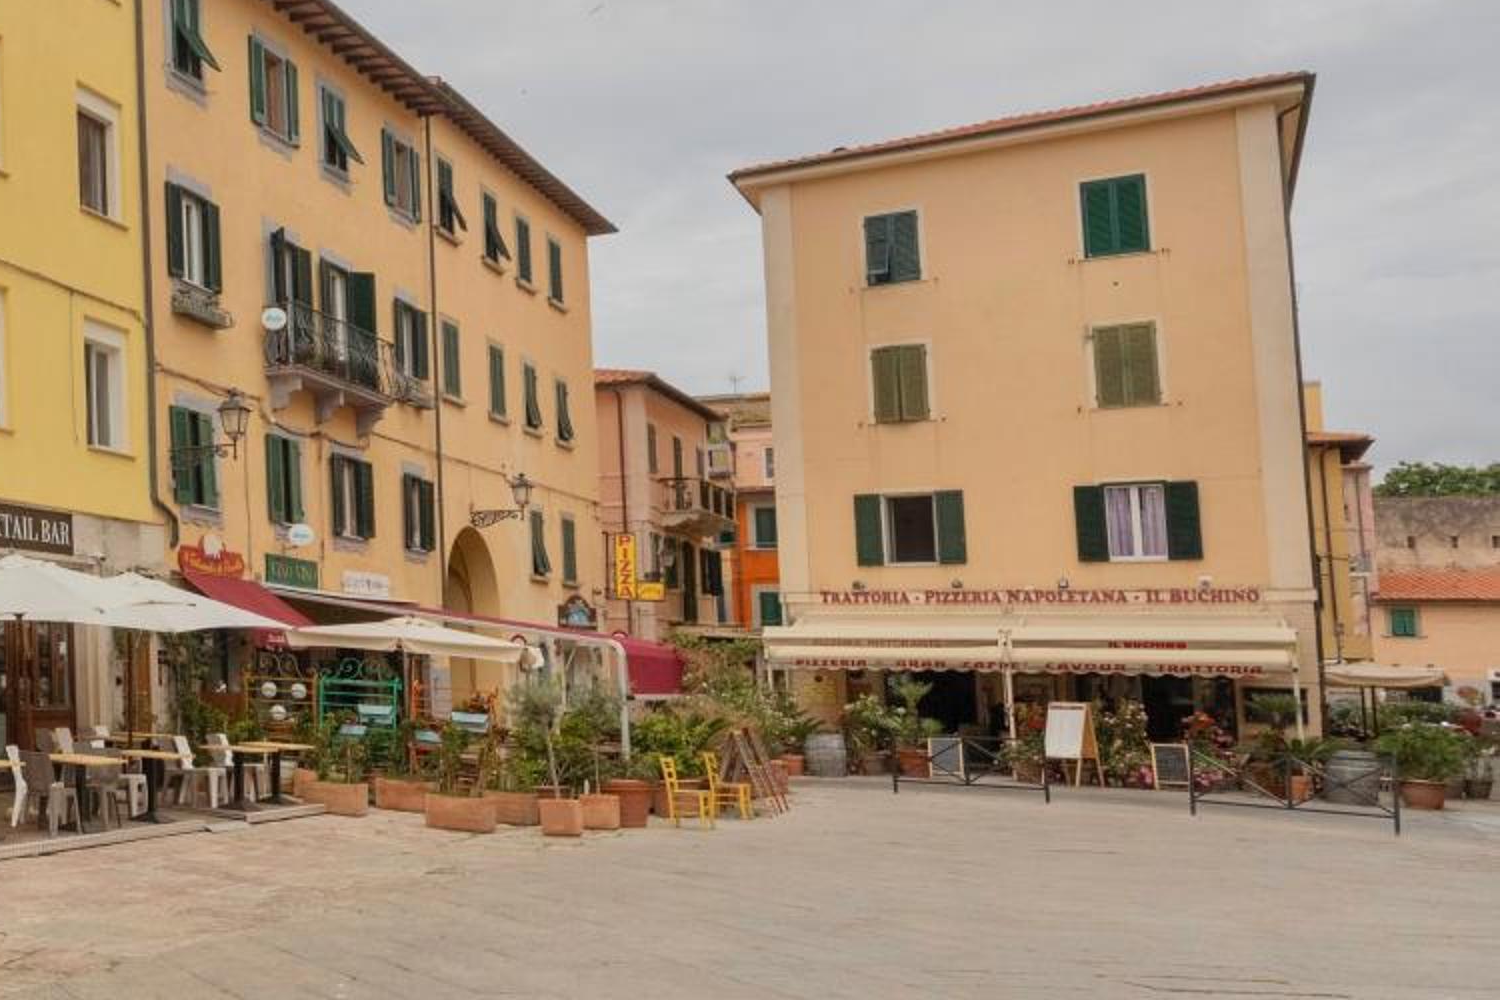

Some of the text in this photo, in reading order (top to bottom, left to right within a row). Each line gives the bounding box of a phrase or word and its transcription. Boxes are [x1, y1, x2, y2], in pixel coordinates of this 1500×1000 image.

[40, 522, 70, 545] BAR
[619, 535, 633, 597] PIZZA
[820, 588, 1261, 605] TRATTORIA PIZZERIA NAPOLETANA IL BUCHINO
[795, 659, 868, 668] PIZZERIA
[1045, 662, 1126, 672] CAVOUR
[1156, 663, 1264, 674] TRATTORIA
